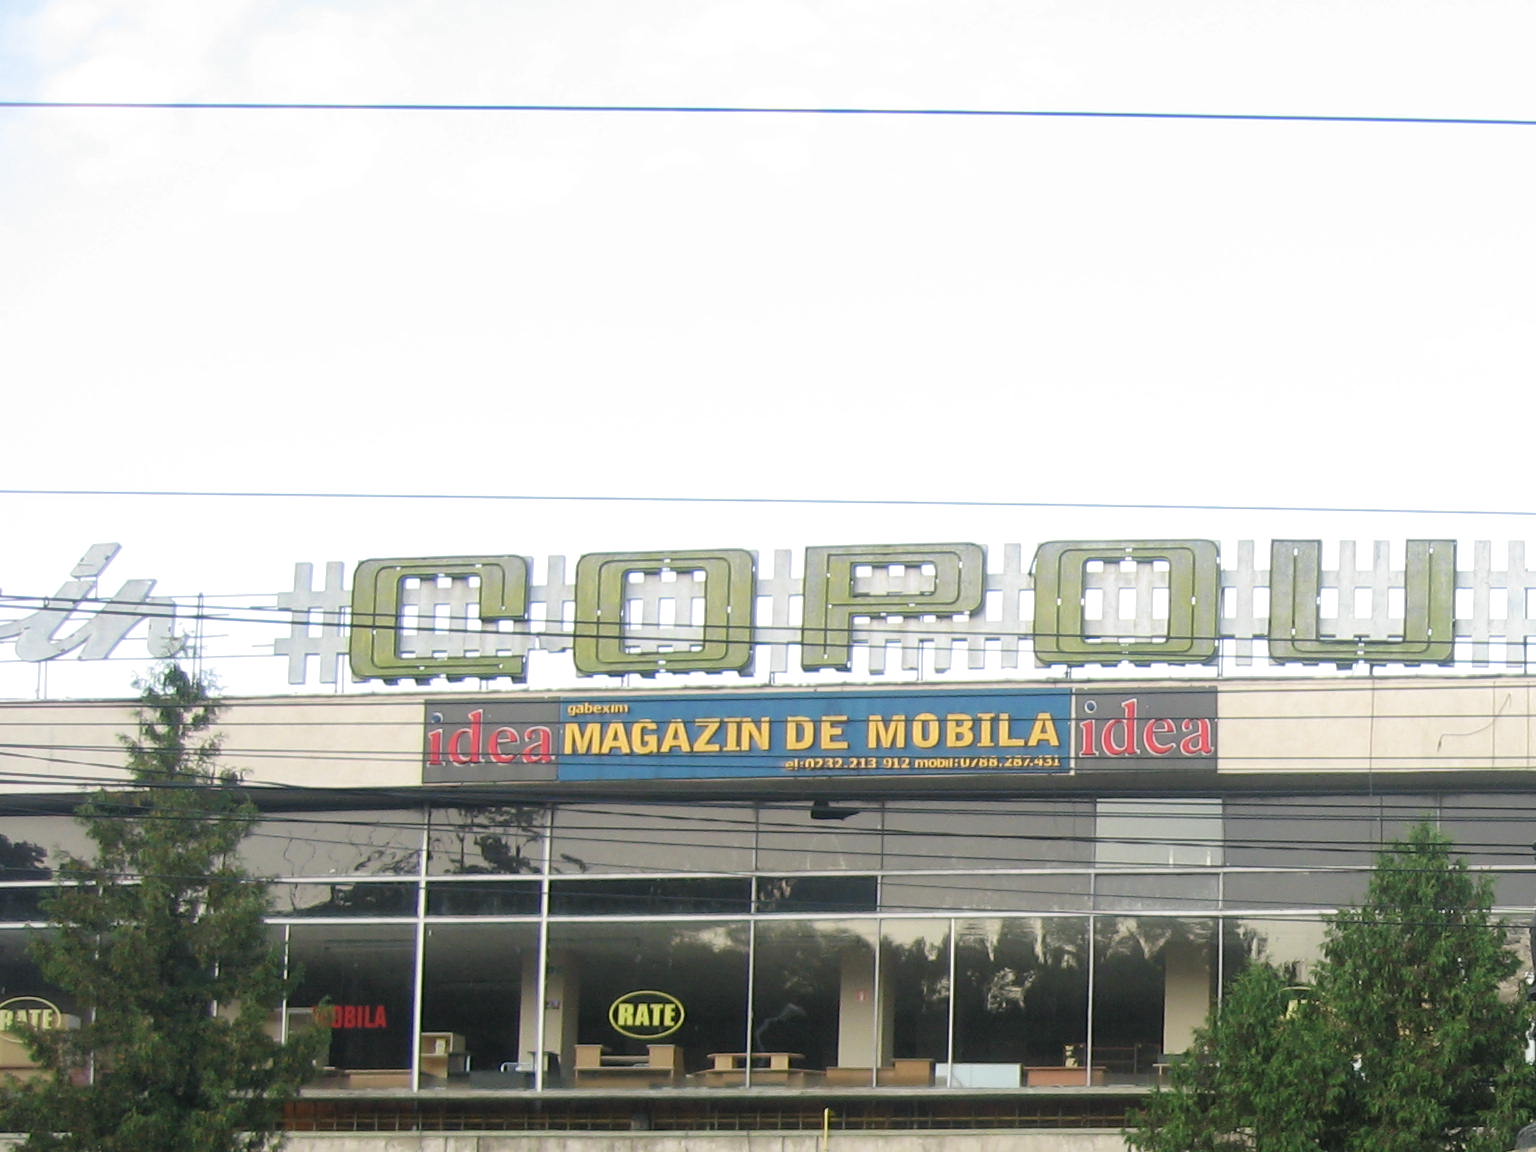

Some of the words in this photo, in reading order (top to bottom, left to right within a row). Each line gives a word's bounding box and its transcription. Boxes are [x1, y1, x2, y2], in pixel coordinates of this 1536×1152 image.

[0, 542, 188, 662] in
[350, 538, 1457, 683] COPOU
[567, 702, 630, 716] gabexim
[1079, 698, 1215, 758] idea
[427, 709, 556, 766] idea
[563, 716, 771, 755] MAGAZIN
[786, 715, 849, 750] DE
[867, 712, 1060, 749] MOBILA
[313, 1005, 388, 1028] OBILA
[618, 1003, 676, 1026] RATE
